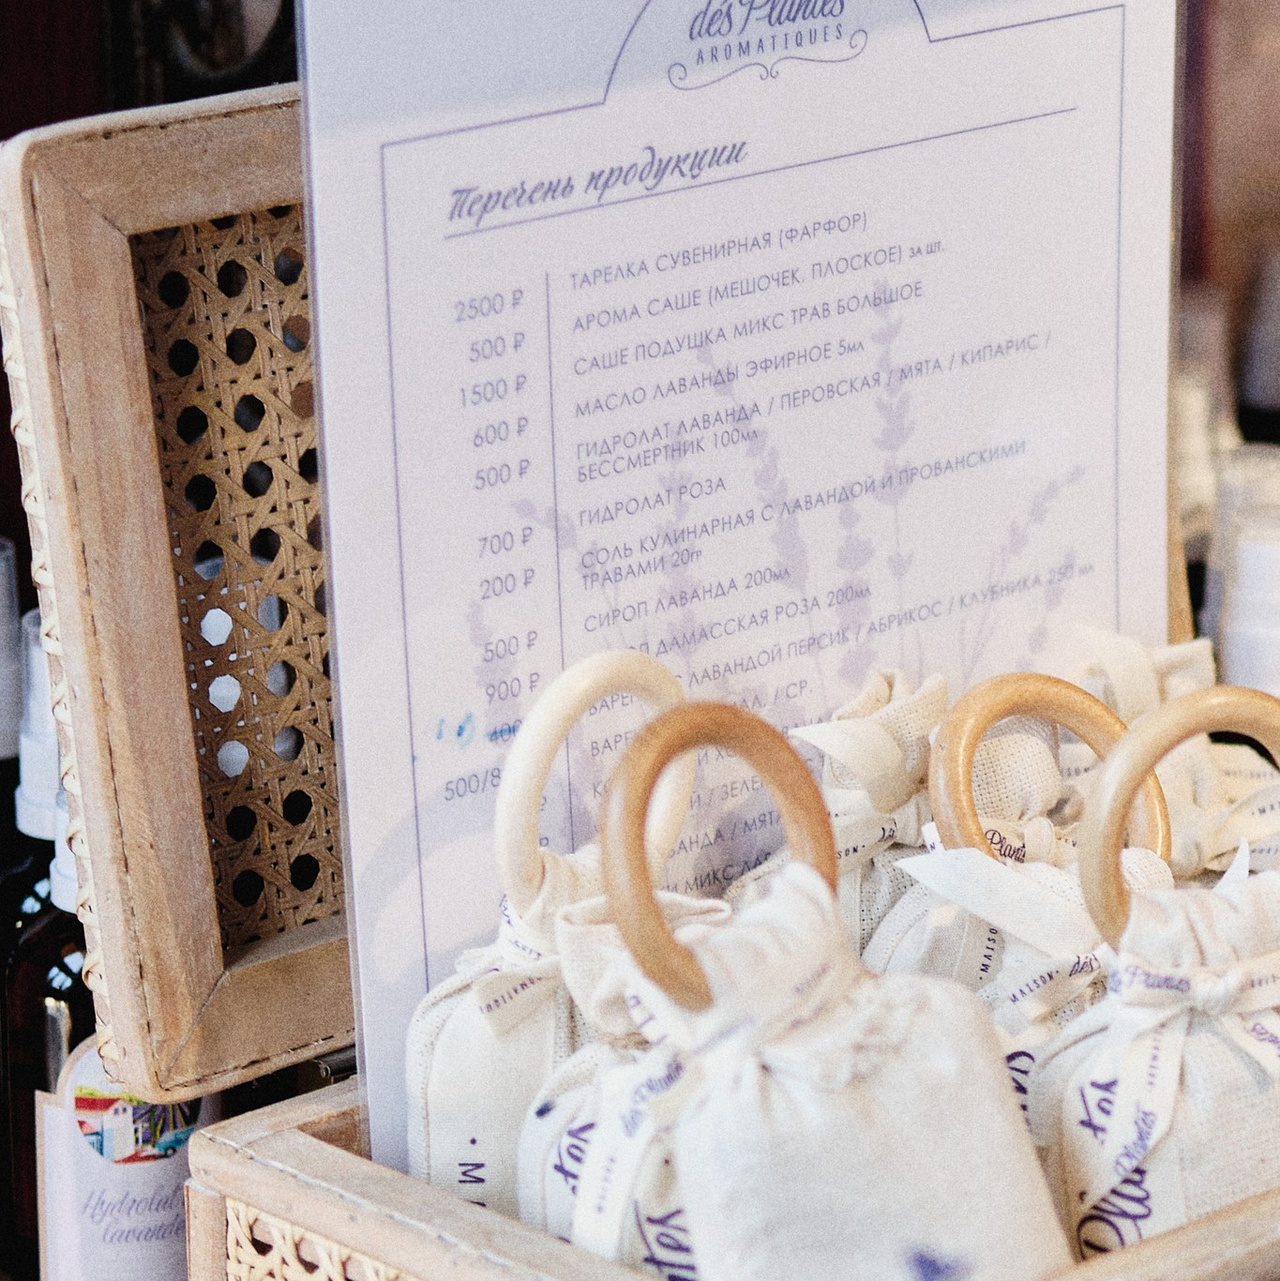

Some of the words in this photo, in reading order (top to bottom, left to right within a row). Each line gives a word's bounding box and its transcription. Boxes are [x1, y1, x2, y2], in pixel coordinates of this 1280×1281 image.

[696, 22, 843, 66] AROMATIQUES
[449, 175, 575, 228] Перечень
[584, 140, 748, 203] продукции
[571, 259, 650, 291] ТАРЕЛКА
[655, 232, 772, 273] СУВЕНИРНАЯ
[779, 211, 867, 249] (ФАРФОР)
[453, 293, 505, 323] 2500
[573, 303, 641, 335] АРОМА
[647, 288, 702, 317] САШЕ
[812, 244, 902, 280] ПЛОСКОЕ)
[469, 336, 506, 363] 500
[574, 347, 628, 376] САШЕ
[635, 326, 727, 362] ПОДУШКА
[733, 312, 784, 339] МИКС
[791, 301, 831, 327] ТРАВ
[836, 281, 924, 316] БОЛЬШОЕ
[460, 378, 508, 408] 1500
[575, 386, 647, 418] МАСЛО
[653, 364, 740, 400] ЛАВАНДЫ
[746, 341, 832, 378] ЭФИРНОЕ
[577, 422, 671, 461] ГИДРОЛАТ
[677, 401, 763, 435] ЛАВАНДА
[781, 370, 881, 412] ПЕРОВСКАЯ
[899, 358, 943, 382] МЯТА
[961, 333, 1039, 367] КИПАРИС
[473, 420, 510, 448] 600
[474, 463, 511, 491] 500
[577, 435, 705, 484] БЕССМЕРТНИК
[579, 488, 673, 528] ГИДРОЛАТ
[678, 477, 727, 503] РОЗА
[581, 542, 633, 570] СОЛЬ
[639, 509, 756, 553] КУЛИНАРНАЯ
[761, 504, 774, 522] С
[781, 476, 876, 518] ЛАВАНДОЙ
[899, 439, 1027, 487] ПРОВАНСКИМИ
[478, 531, 514, 558] 700
[480, 573, 517, 600] 200
[582, 558, 666, 592] ТРАВАМИ
[584, 600, 649, 633] СИРОП
[655, 577, 739, 614] ЛАВАНДА
[655, 608, 770, 657] ДАМАССКАЯ
[775, 595, 822, 621] РОЗА
[483, 635, 519, 663] 500
[689, 645, 783, 688] ЛАВАНДОЙ
[787, 626, 850, 659] ПЕРСИК
[868, 600, 942, 636] АБРИКОС
[485, 677, 521, 705] 900
[980, 927, 999, 974] MAISO
[1009, 969, 1055, 1005] MAISON
